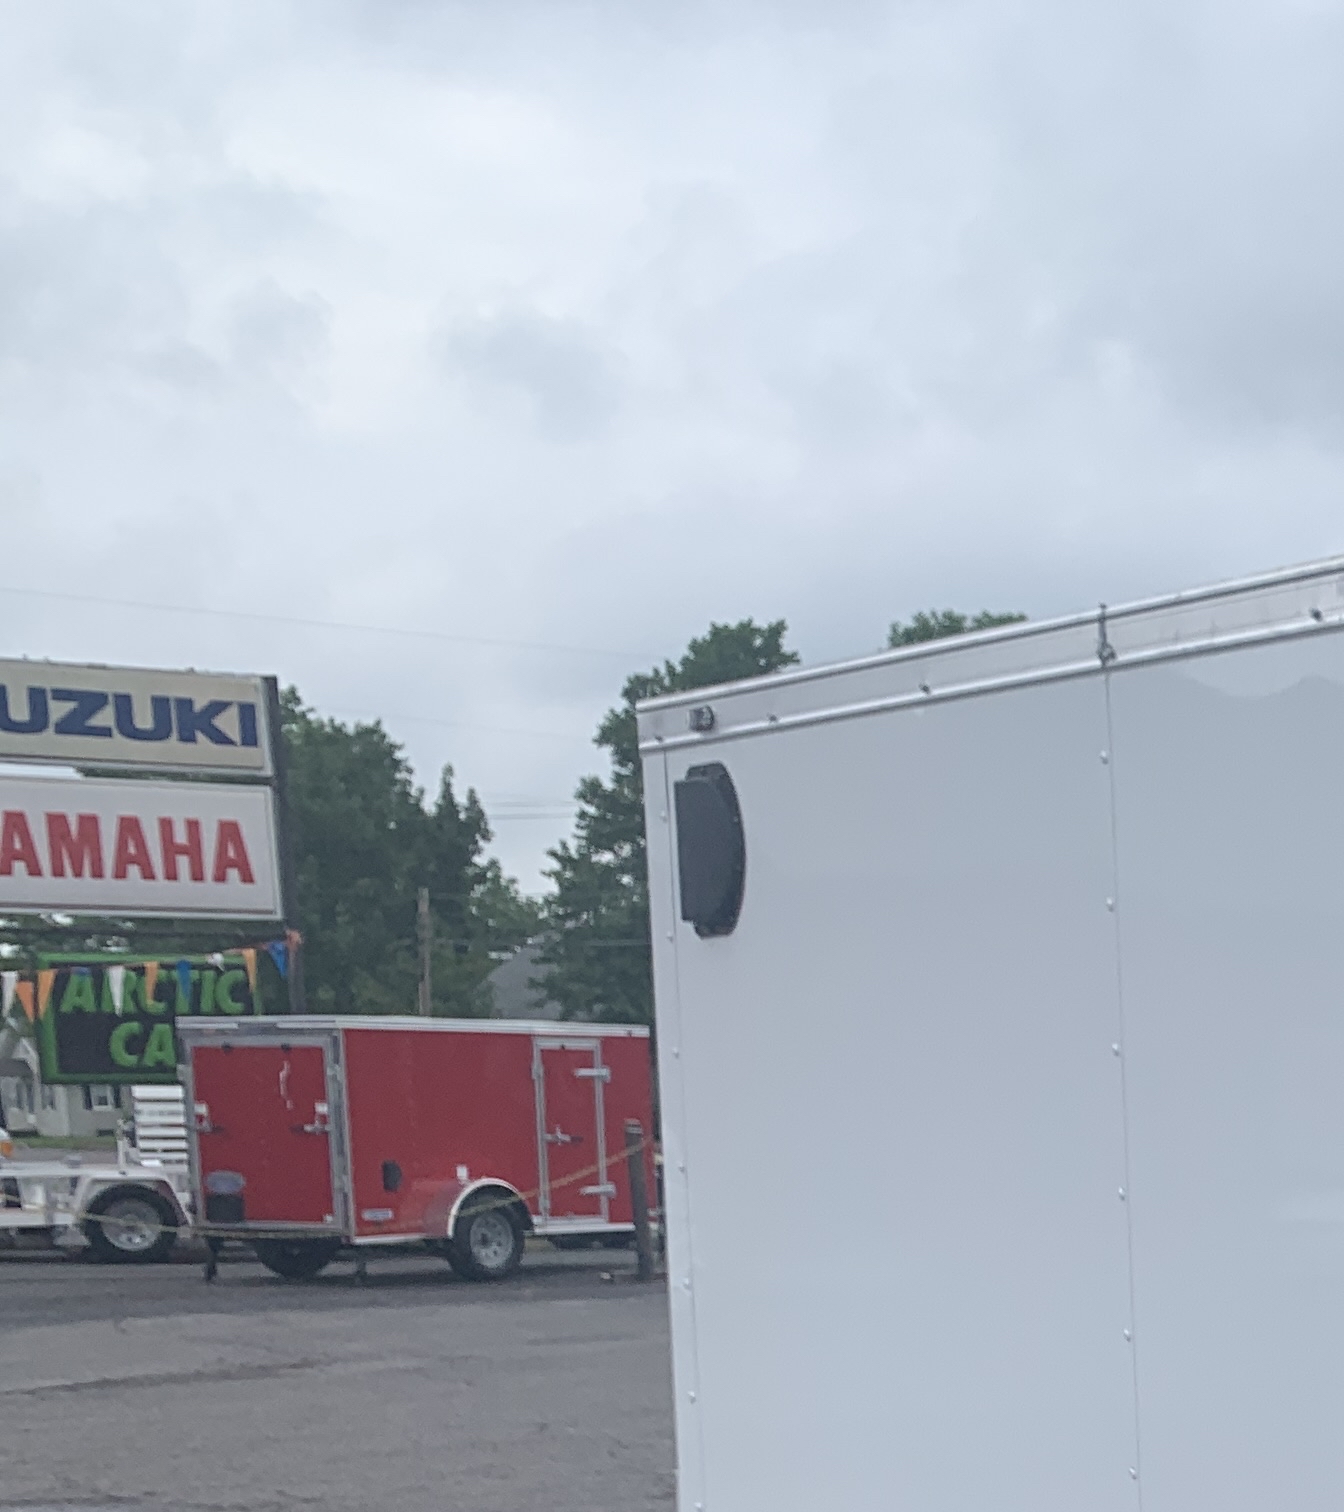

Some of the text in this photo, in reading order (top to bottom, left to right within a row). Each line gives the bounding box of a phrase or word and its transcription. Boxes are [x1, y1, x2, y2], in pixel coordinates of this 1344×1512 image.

[0, 683, 258, 747] UZUKI
[0, 810, 255, 884] AMAHA
[60, 967, 245, 1015] ARCTIC
[109, 1020, 176, 1068] CA
